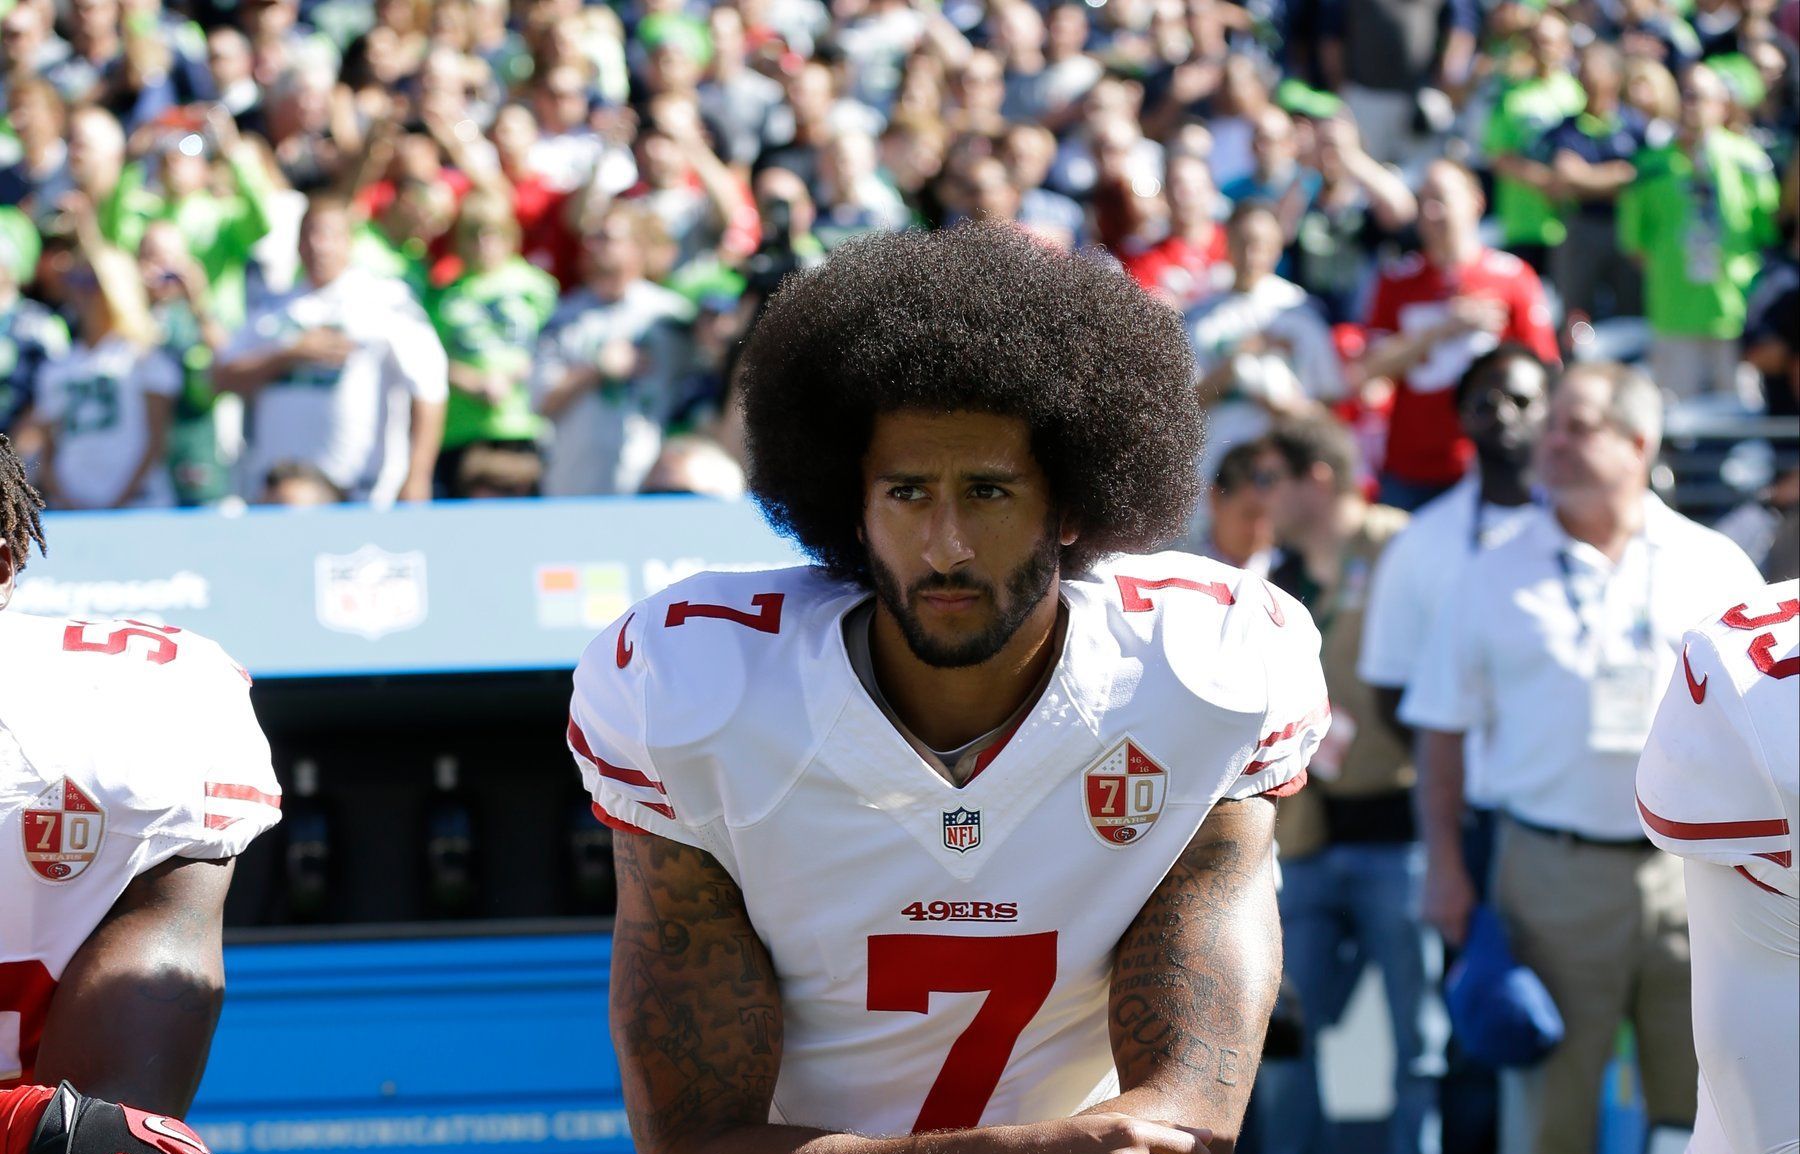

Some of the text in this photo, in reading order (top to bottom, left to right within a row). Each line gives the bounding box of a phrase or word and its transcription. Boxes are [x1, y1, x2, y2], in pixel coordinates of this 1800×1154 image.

[1114, 574, 1236, 613] 7
[664, 592, 785, 635] 7
[1129, 756, 1142, 764] 46
[1099, 780, 1154, 813] 70
[36, 815, 90, 849] 70
[946, 826, 978, 848] NFL
[1104, 816, 1147, 825] YEARS
[40, 853, 82, 861] YEARS
[901, 900, 1018, 921] 49ERS
[866, 930, 1058, 1136] 7
[251, 1114, 548, 1151] COMMUNICATIONS
